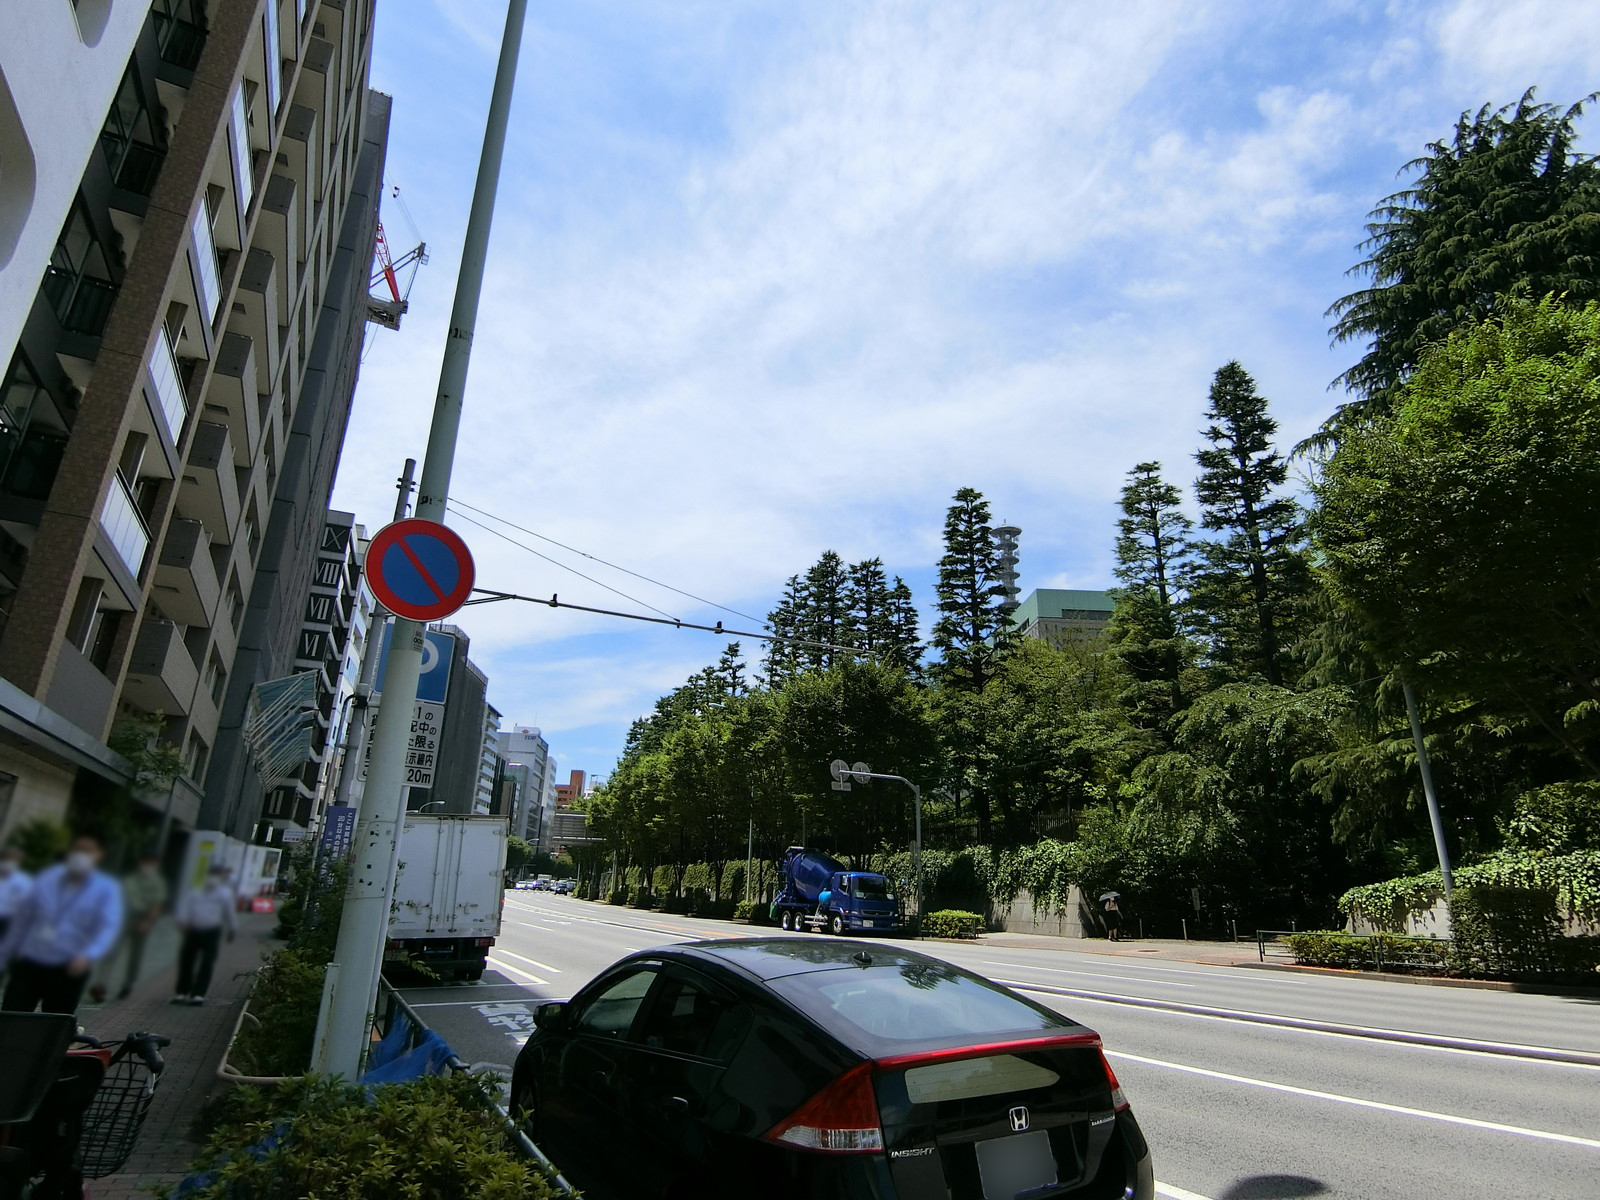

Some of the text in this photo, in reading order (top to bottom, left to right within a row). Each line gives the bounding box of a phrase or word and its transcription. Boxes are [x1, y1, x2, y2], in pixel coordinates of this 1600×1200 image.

[310, 596, 330, 620] VII
[305, 632, 320, 657] VI
[412, 706, 434, 721] 1の
[406, 751, 433, 767] 示線内
[407, 768, 431, 784] 20m
[891, 1147, 935, 1158] INSIGHT
